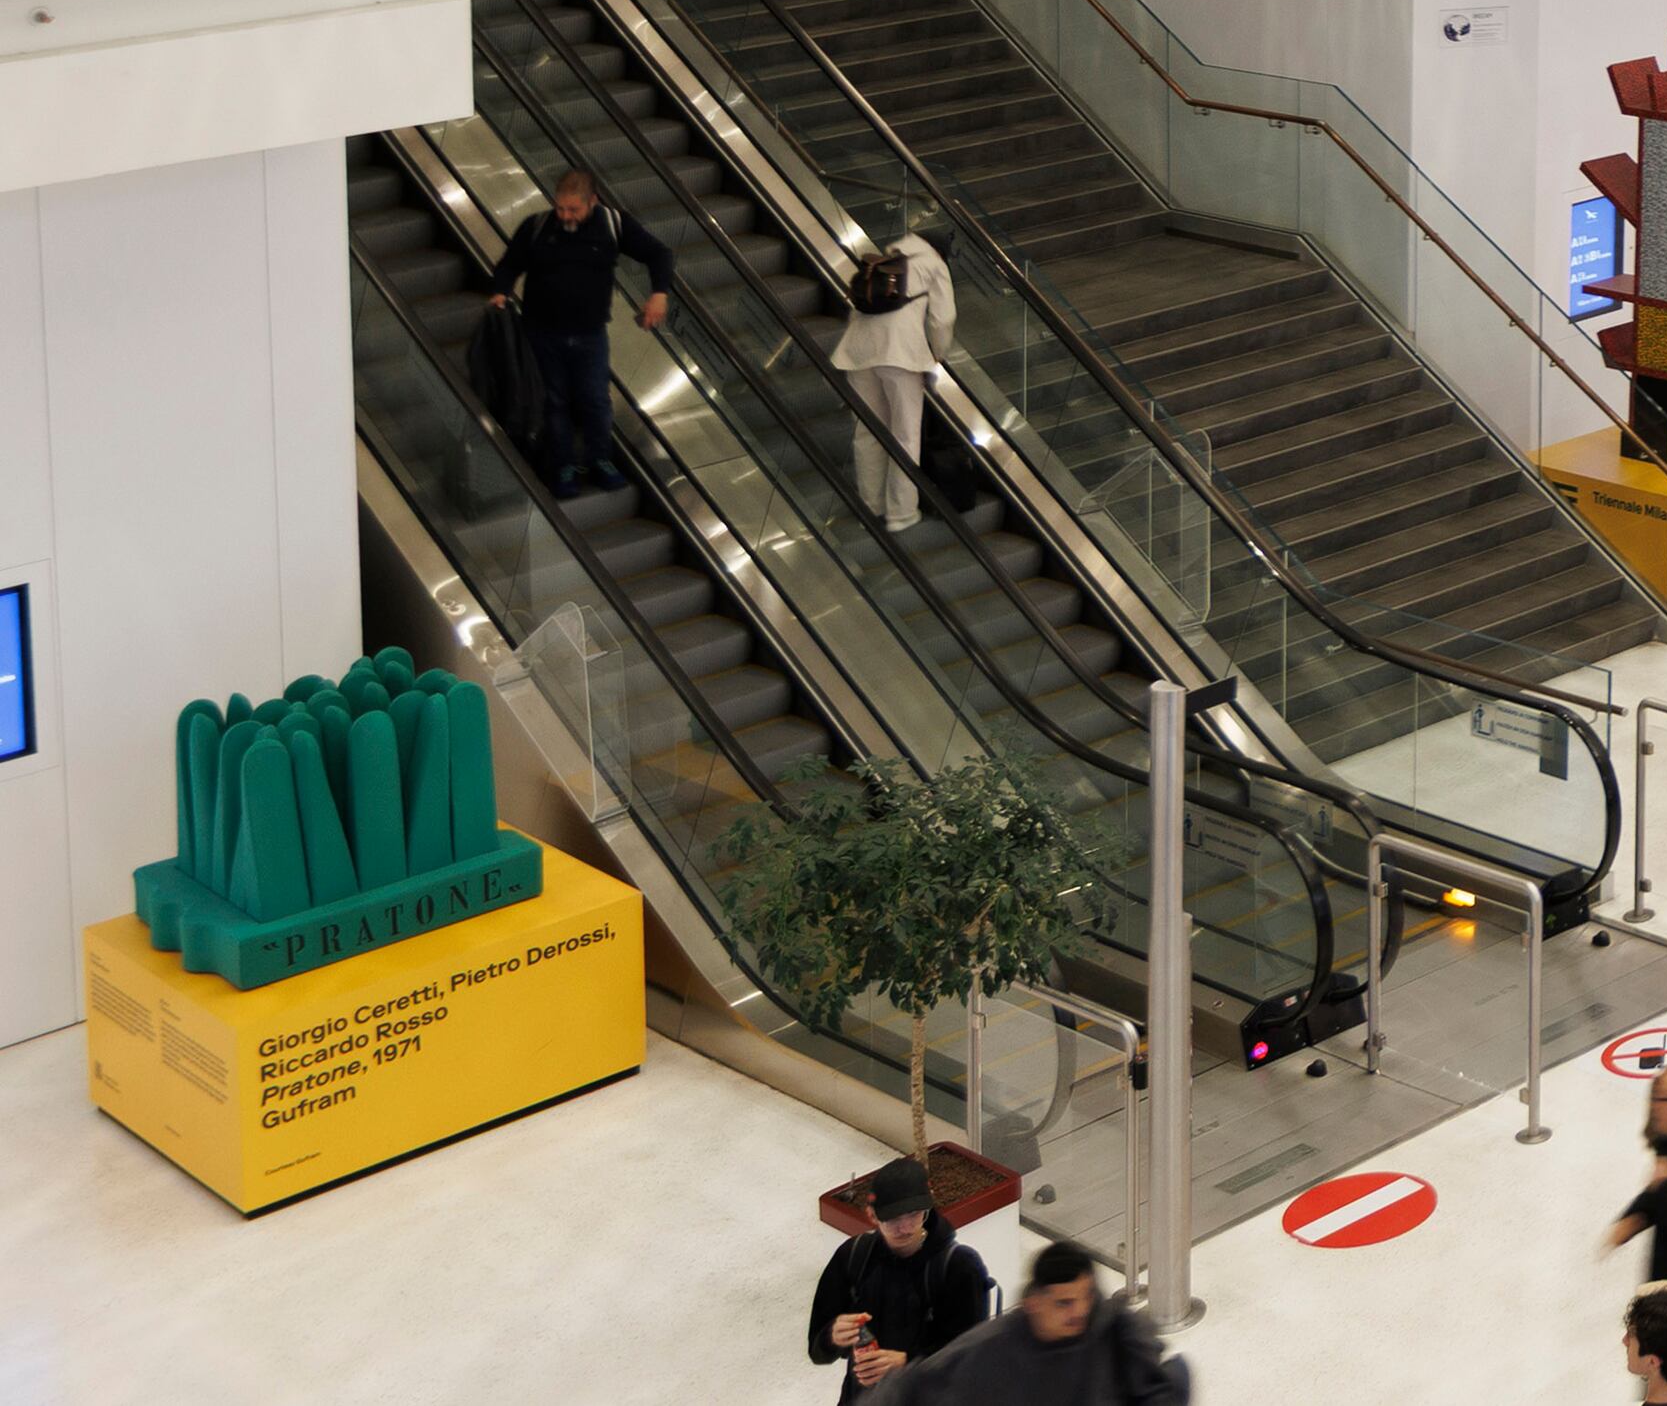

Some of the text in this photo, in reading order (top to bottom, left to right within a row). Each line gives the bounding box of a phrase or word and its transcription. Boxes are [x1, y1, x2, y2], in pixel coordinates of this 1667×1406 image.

[1592, 490, 1642, 515] Triennale
[258, 1014, 349, 1060] Giorgio
[353, 983, 446, 1025] Ceretti,
[449, 954, 521, 993] Pietro
[525, 921, 617, 967] Derossi,
[259, 1029, 370, 1083] Riccardo
[374, 1005, 449, 1042] Rosso
[260, 1035, 422, 1108] Pratone, 1971
[261, 1083, 357, 1131] Gufram
